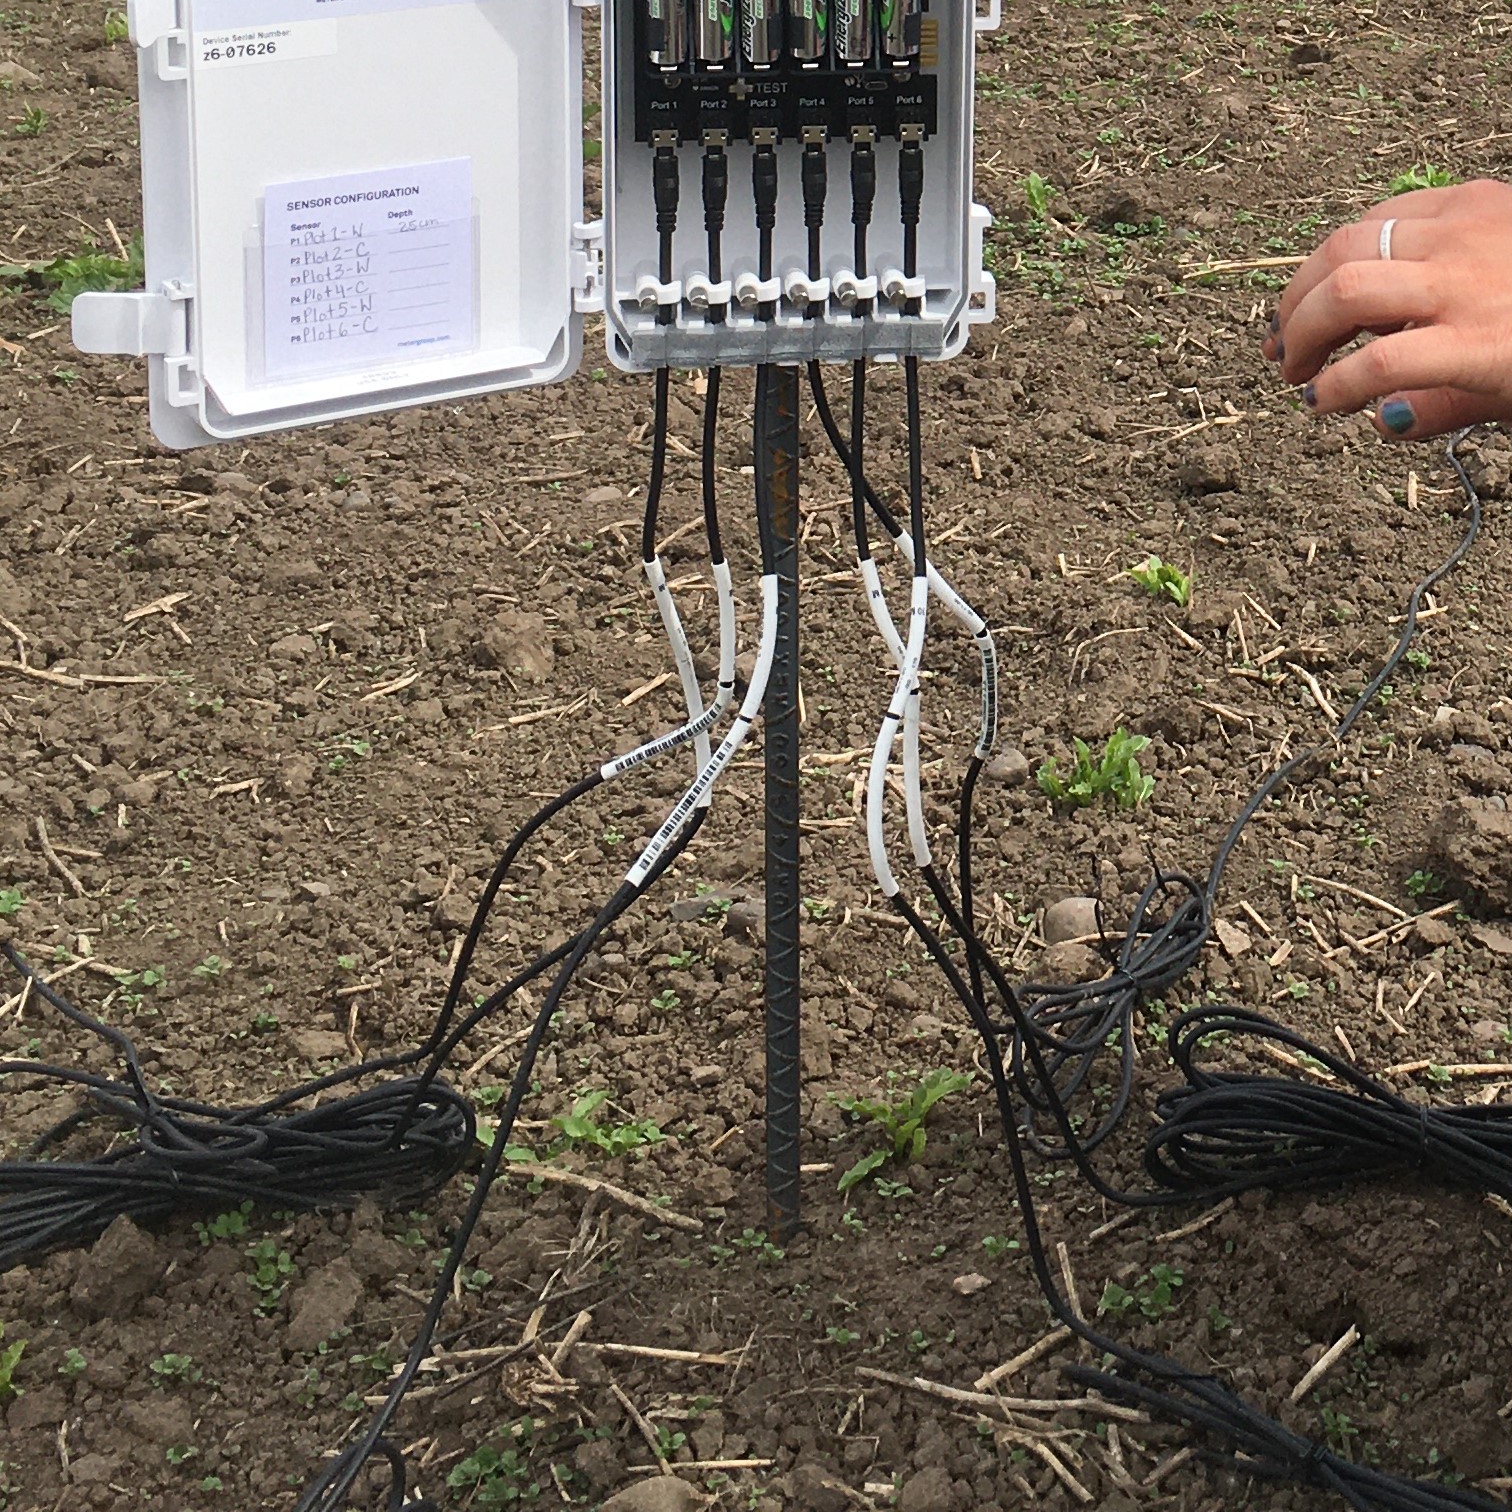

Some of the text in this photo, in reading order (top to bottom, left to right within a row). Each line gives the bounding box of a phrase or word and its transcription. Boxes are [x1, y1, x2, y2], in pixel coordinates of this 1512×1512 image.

[202, 36, 230, 46] Device
[231, 32, 256, 43] Serial
[202, 41, 277, 62] z6-07626
[755, 82, 788, 94] TEST
[700, 99, 727, 109] Port 2
[750, 98, 777, 108] Port 3
[799, 97, 826, 107] Port 4
[848, 96, 866, 105] Port
[896, 95, 922, 104] Port 6
[651, 100, 678, 110] Port 1
[286, 185, 420, 212] SENSOR CONFIGURATION
[387, 209, 414, 220] Depth
[290, 221, 322, 232] Sensor
[290, 237, 300, 246] P1
[290, 256, 301, 265] P2
[290, 276, 301, 285] P3
[290, 296, 301, 304] P4
